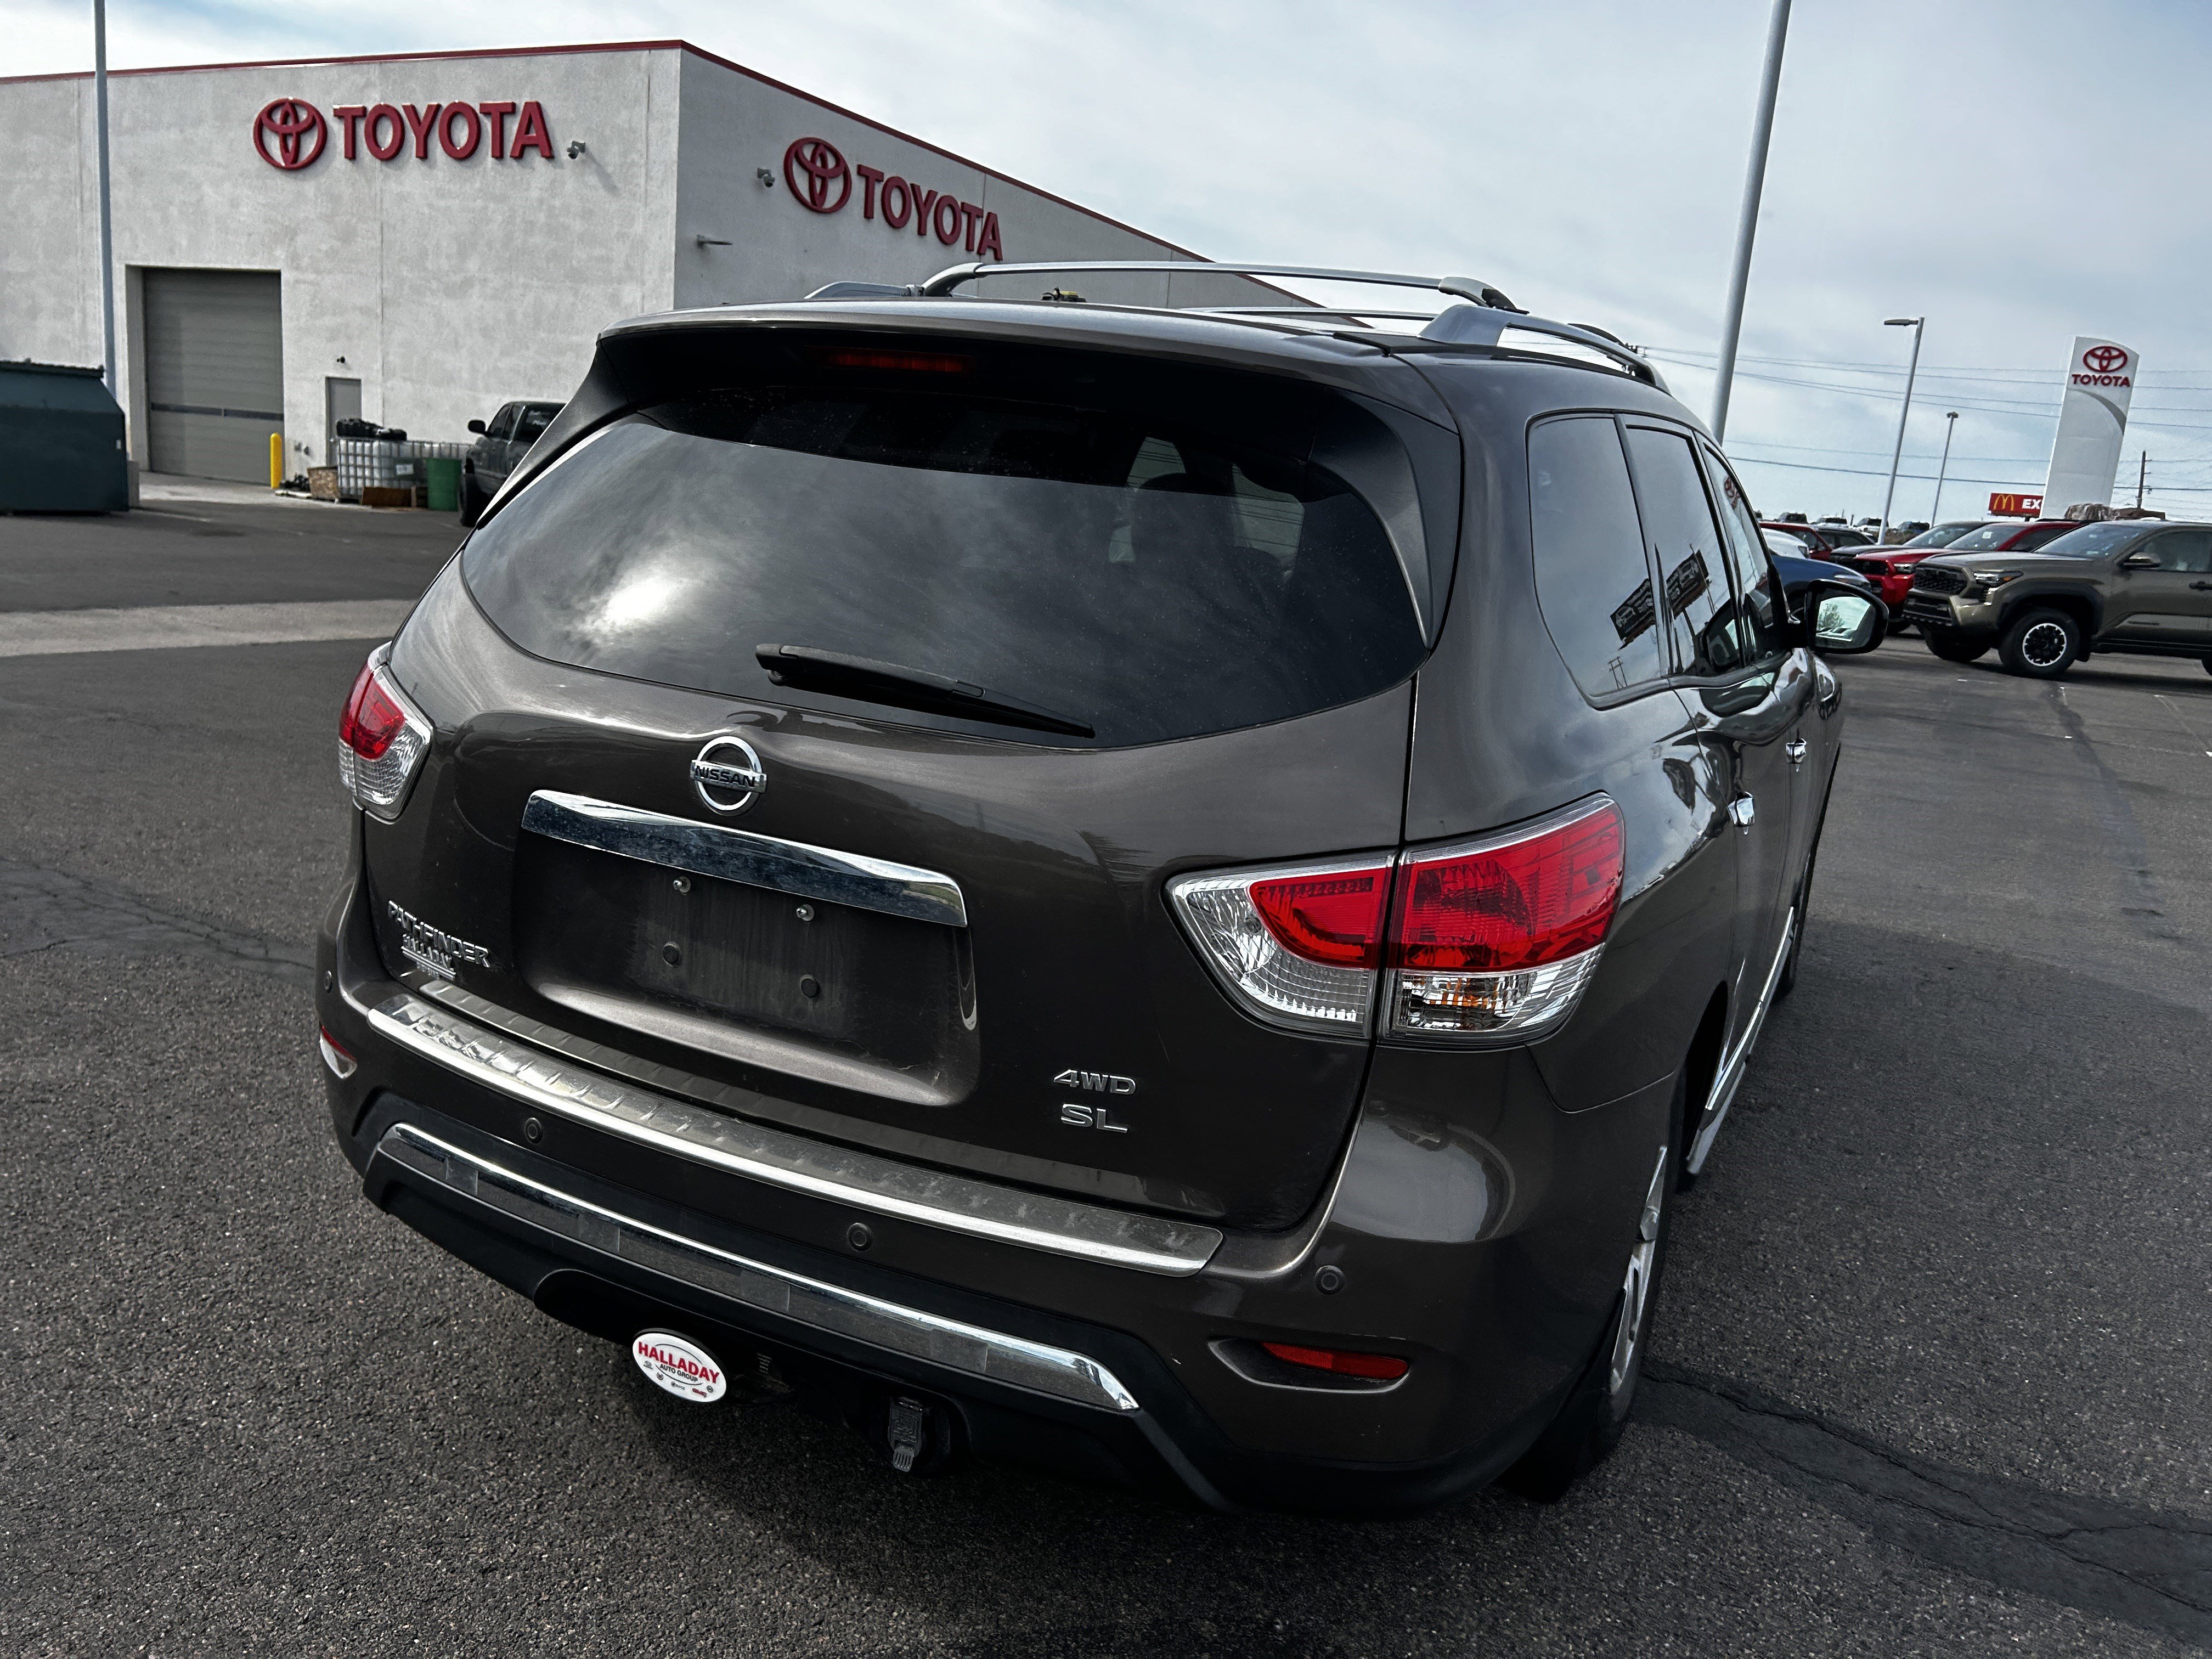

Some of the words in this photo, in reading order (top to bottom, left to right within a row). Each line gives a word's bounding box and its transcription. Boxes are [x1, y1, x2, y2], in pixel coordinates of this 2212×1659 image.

[332, 100, 554, 160] TOYOTA
[857, 164, 1003, 261] TOYOTA
[2072, 374, 2130, 387] TOYOTA
[695, 765, 755, 787] NISSAN
[388, 900, 491, 968] PATHFINDER
[1053, 1069, 1136, 1094] 4WD
[1060, 1103, 1128, 1133] SL
[638, 1341, 720, 1384] HALLADAY
[659, 1363, 676, 1374] AUTO
[677, 1370, 698, 1383] GROUP
